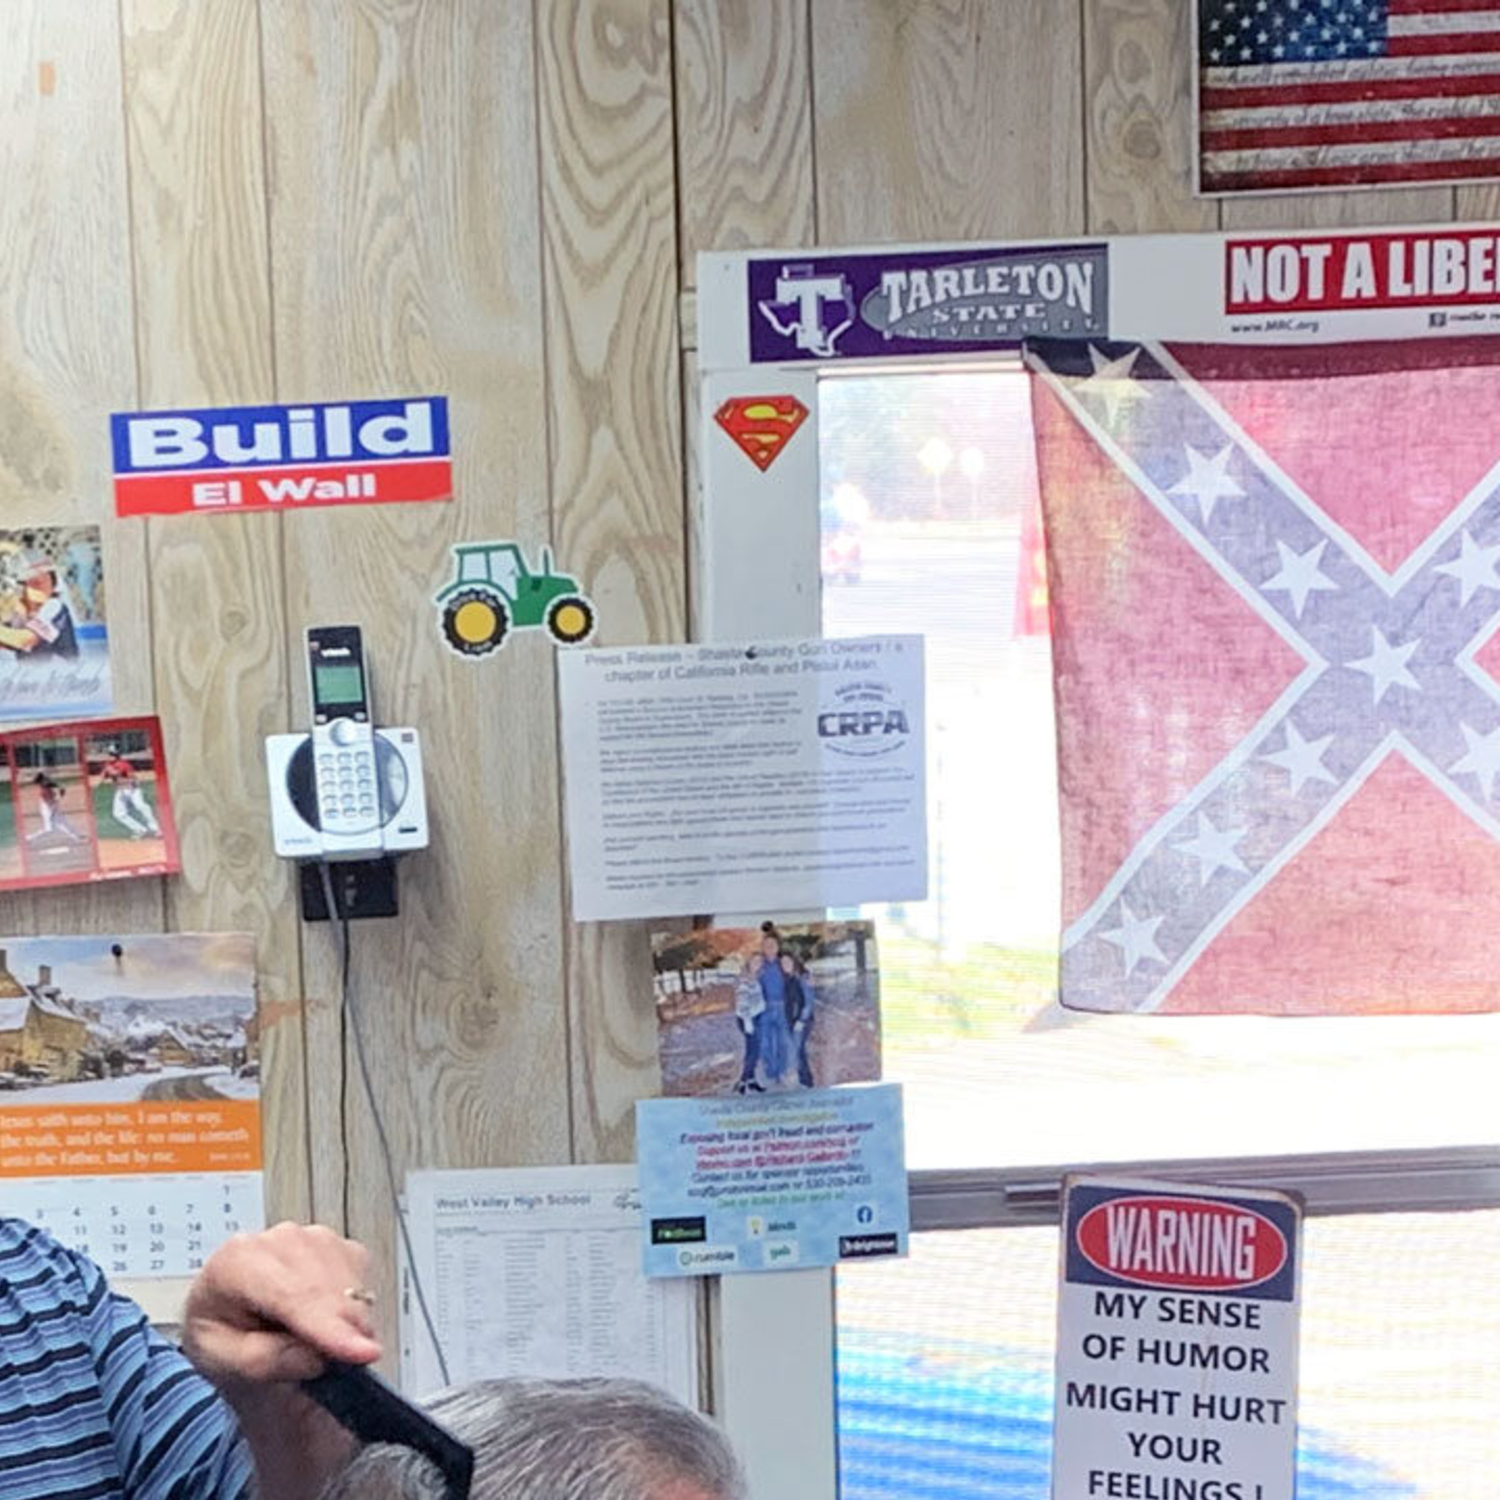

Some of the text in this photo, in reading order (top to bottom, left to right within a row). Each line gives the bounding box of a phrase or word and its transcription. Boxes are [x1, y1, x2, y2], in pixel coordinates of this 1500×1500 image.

[1231, 236, 1500, 305] NOT A LIBE
[881, 262, 1094, 325] TARLETON
[932, 303, 1046, 323] STATE
[127, 401, 435, 468] Build
[191, 474, 377, 506] El Wall
[604, 669, 654, 683] chapter
[657, 666, 672, 681] of
[674, 664, 736, 681] California
[738, 661, 770, 677] Rifle
[773, 661, 799, 676] and
[817, 708, 910, 737] CRPA
[66, 1130, 90, 1145] and
[93, 1130, 116, 1144] the
[73, 1207, 82, 1218] 4
[110, 1206, 119, 1217] 5
[223, 1202, 232, 1214] 8
[436, 1193, 592, 1211] West Valley High School
[112, 1224, 127, 1236] 12
[1106, 1204, 1256, 1281] WARNING
[150, 1241, 165, 1253] 20
[113, 1260, 128, 1272] 26
[150, 1259, 165, 1271] 27
[1095, 1291, 1261, 1330] MY SENSE
[1082, 1333, 1271, 1374] OF HUMOR
[1066, 1381, 1287, 1425] MIGHT HURT
[1128, 1432, 1222, 1465] YOUR
